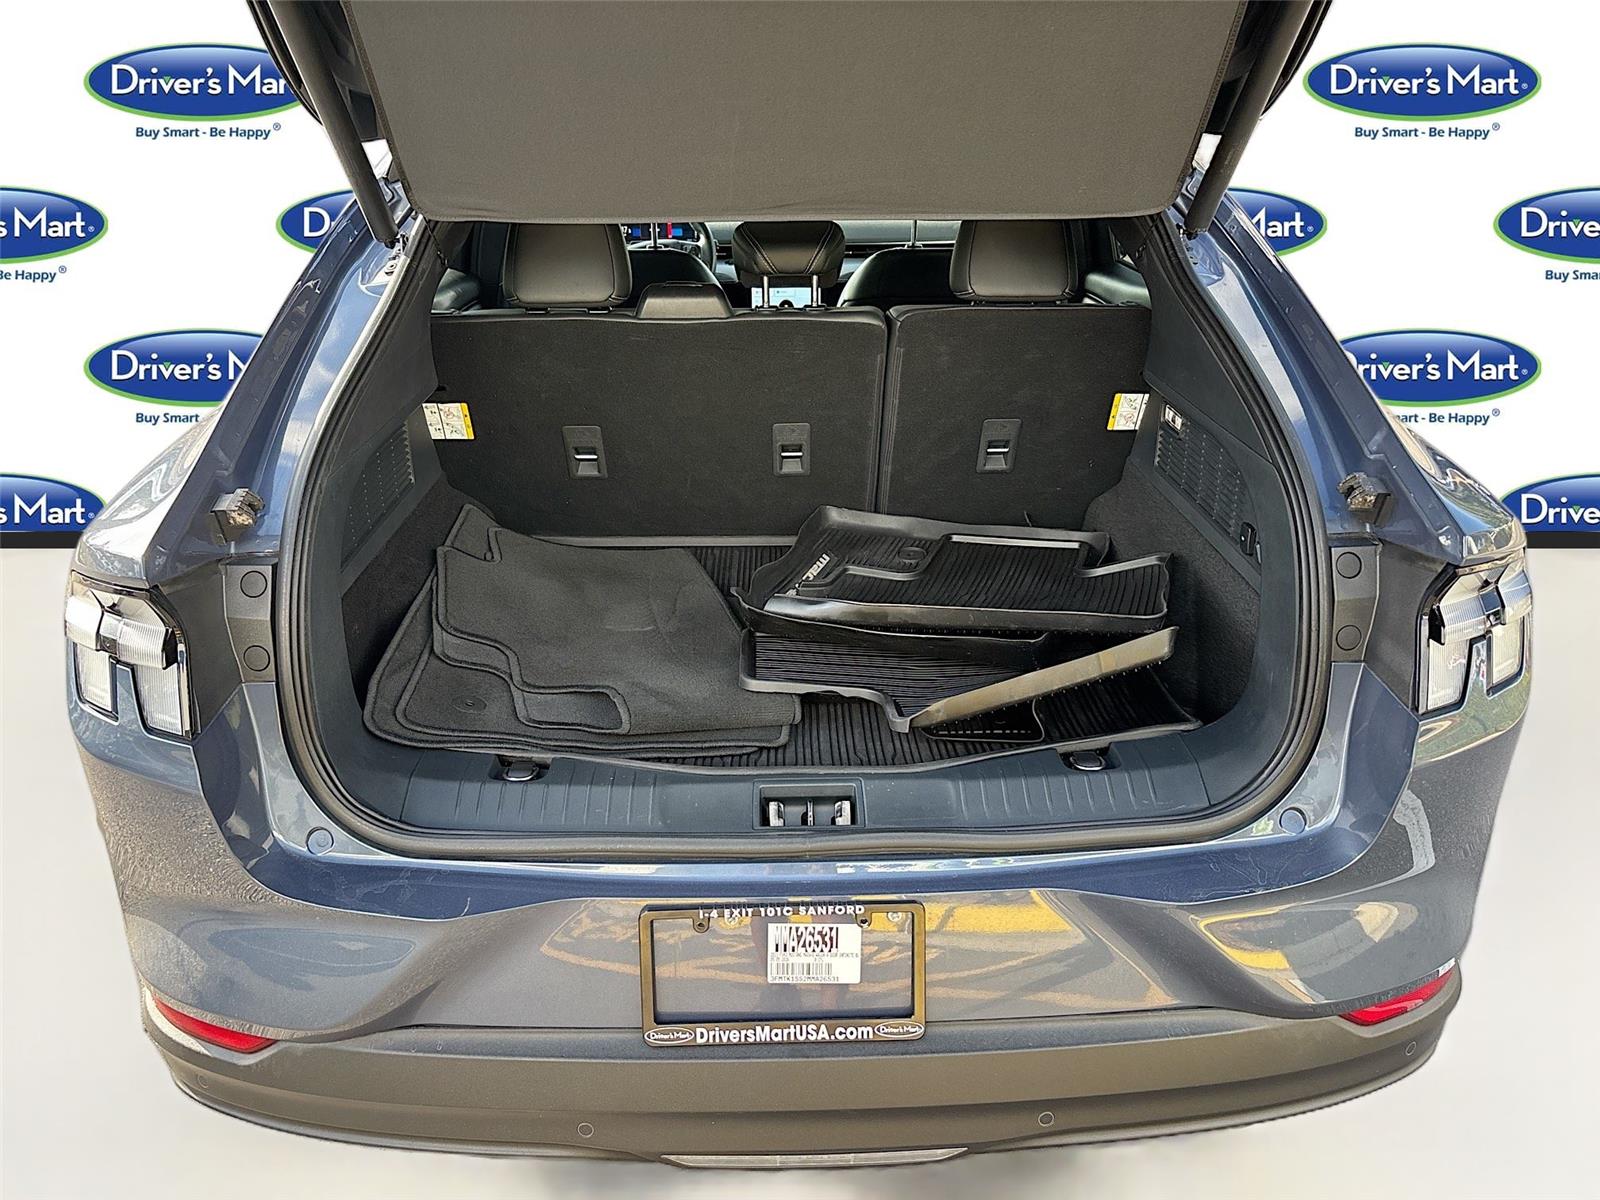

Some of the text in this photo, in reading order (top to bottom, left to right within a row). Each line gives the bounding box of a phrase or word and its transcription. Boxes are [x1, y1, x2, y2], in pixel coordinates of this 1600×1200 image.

[111, 64, 294, 95] Driver's Mar
[1330, 64, 1519, 95] Driver's Mart
[135, 127, 161, 140] Buy
[163, 127, 199, 138] Smart
[209, 127, 226, 138] Be
[1354, 127, 1380, 140] Buy
[1382, 127, 1418, 138] Smart
[1428, 127, 1445, 138] Be
[14, 206, 86, 238] Mart
[1545, 270, 1600, 284] Buy Sma
[111, 350, 222, 381] Driver's
[1447, 350, 1519, 381] Mart
[135, 413, 200, 426] Buy Smart
[1396, 413, 1419, 424] art
[1428, 413, 1445, 424] Be
[14, 491, 86, 524] Mart
[698, 905, 865, 919] I-4 EXIT 101C SANFORD
[695, 1023, 874, 1044] DriversMartUSA.com
